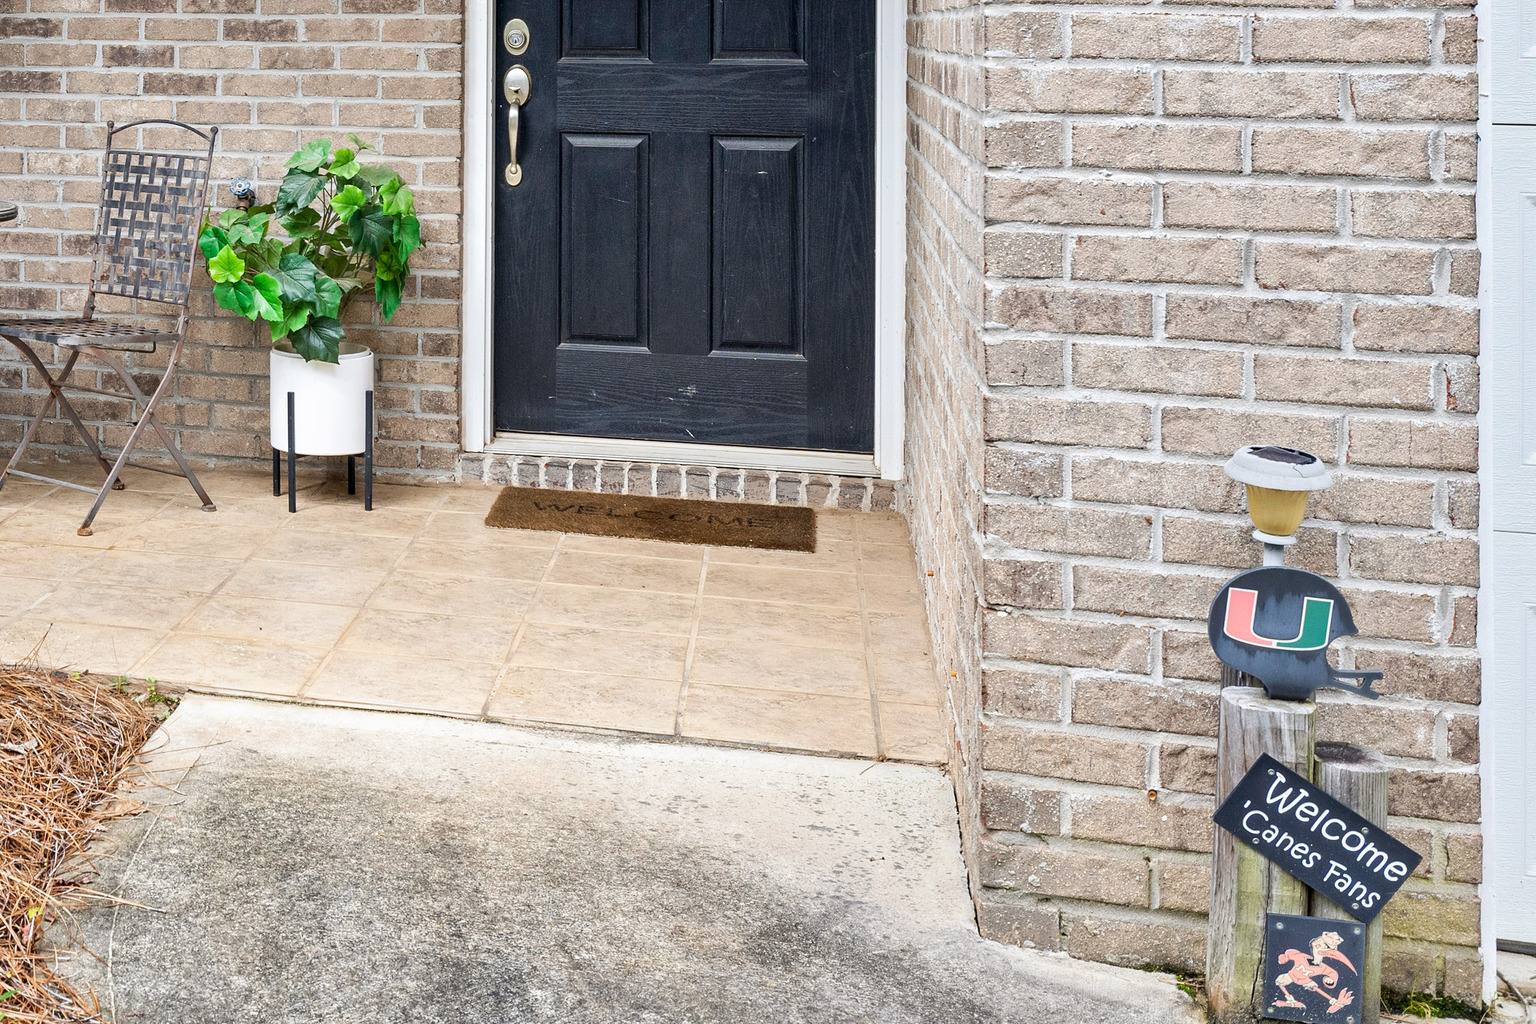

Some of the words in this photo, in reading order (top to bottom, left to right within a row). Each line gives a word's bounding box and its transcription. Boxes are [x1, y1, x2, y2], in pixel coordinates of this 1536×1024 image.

[533, 500, 775, 529] WELCOME
[1223, 587, 1334, 651] U
[1242, 799, 1322, 869] 'Canes
[1322, 859, 1381, 909] Fans
[1265, 771, 1408, 882] Welcome
